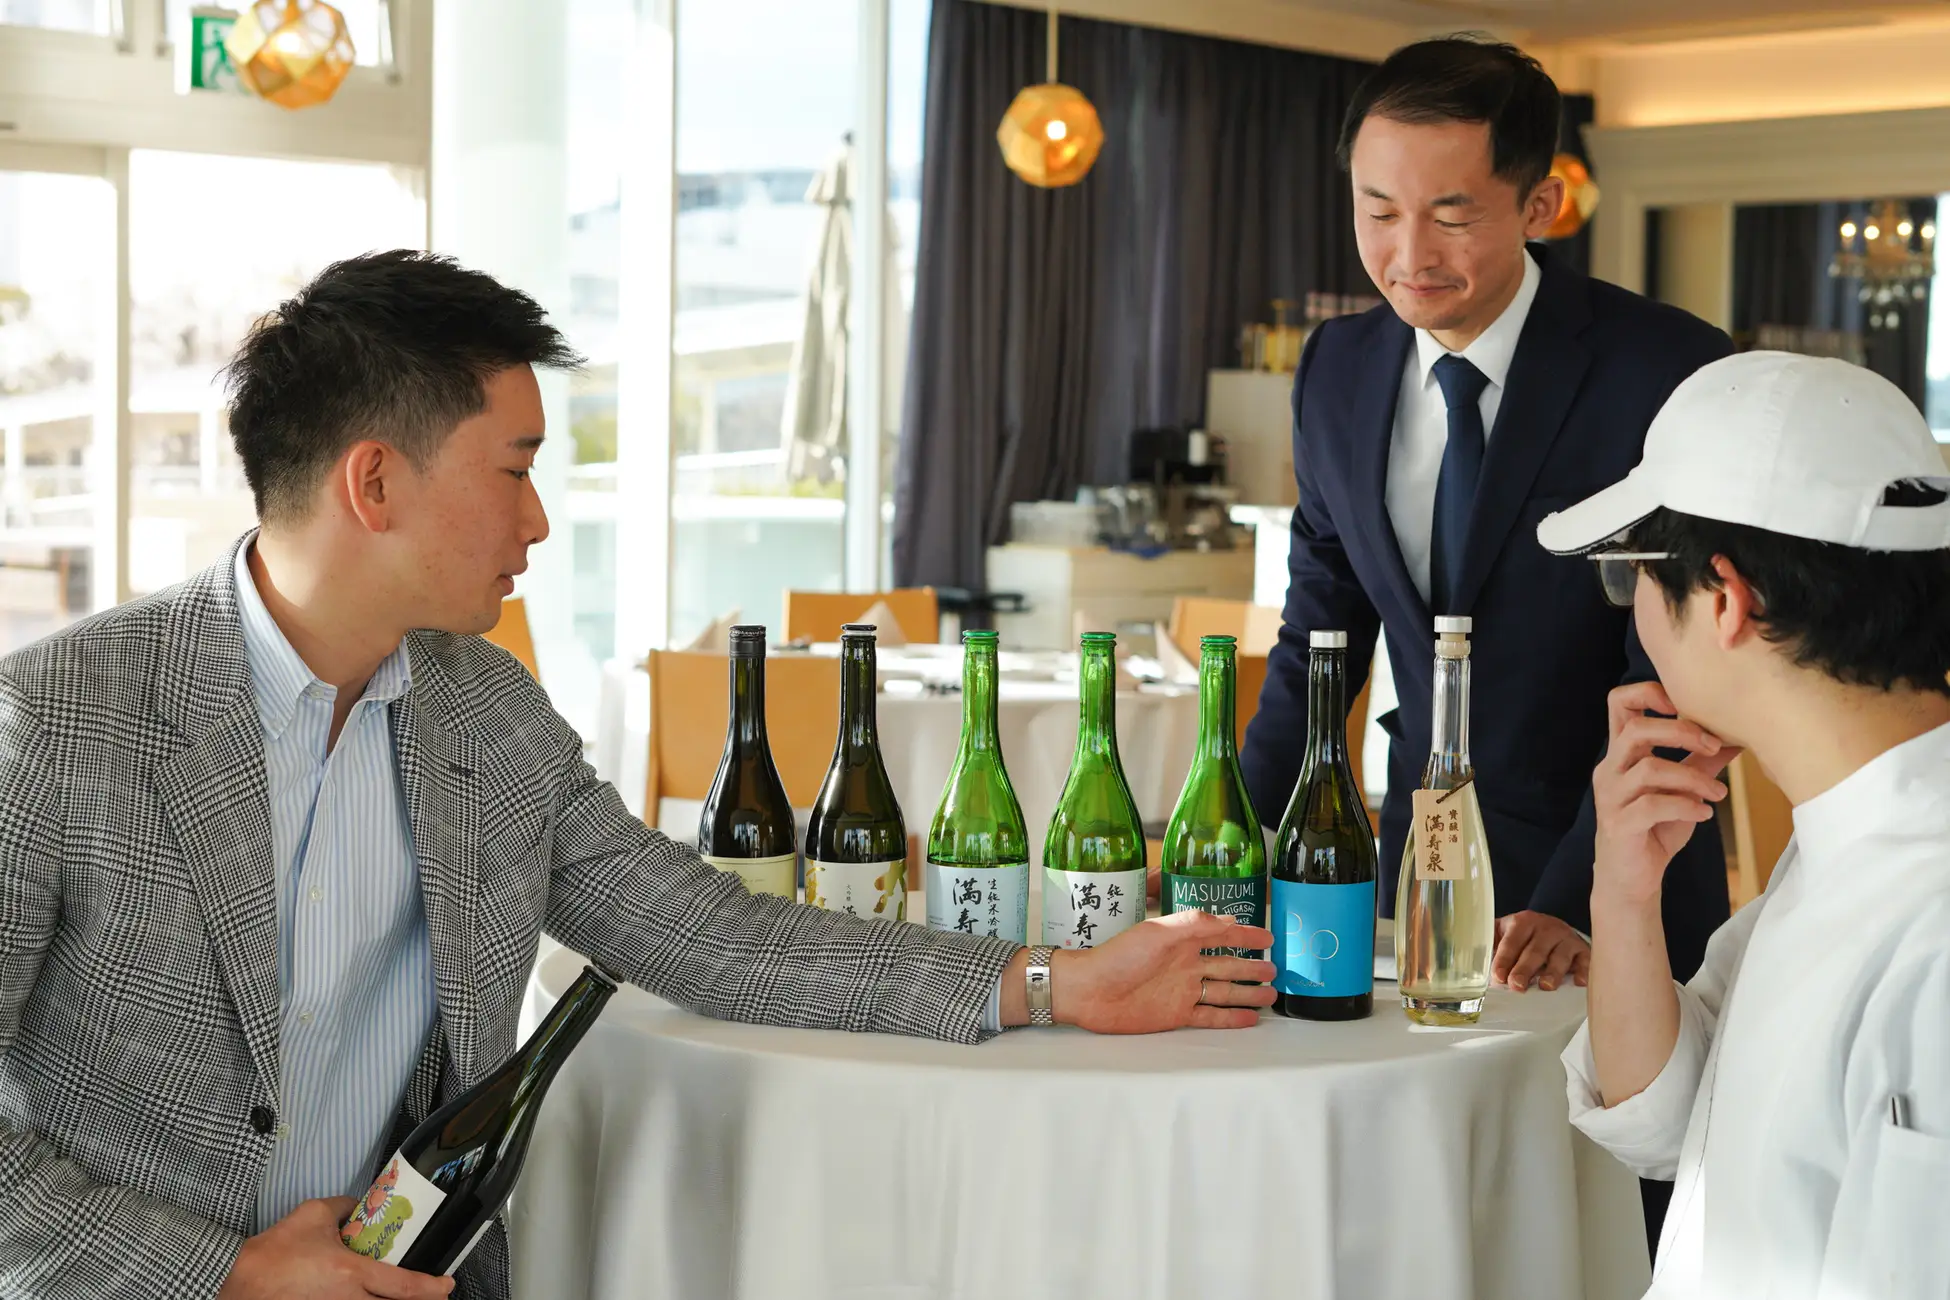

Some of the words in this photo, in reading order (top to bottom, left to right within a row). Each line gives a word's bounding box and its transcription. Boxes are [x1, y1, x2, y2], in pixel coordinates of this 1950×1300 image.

[1425, 814, 1444, 872] 満寿泉
[1107, 883, 1124, 917] 純米
[1174, 881, 1255, 902] MASUIZUMI
[1224, 903, 1255, 916] HIGASHI
